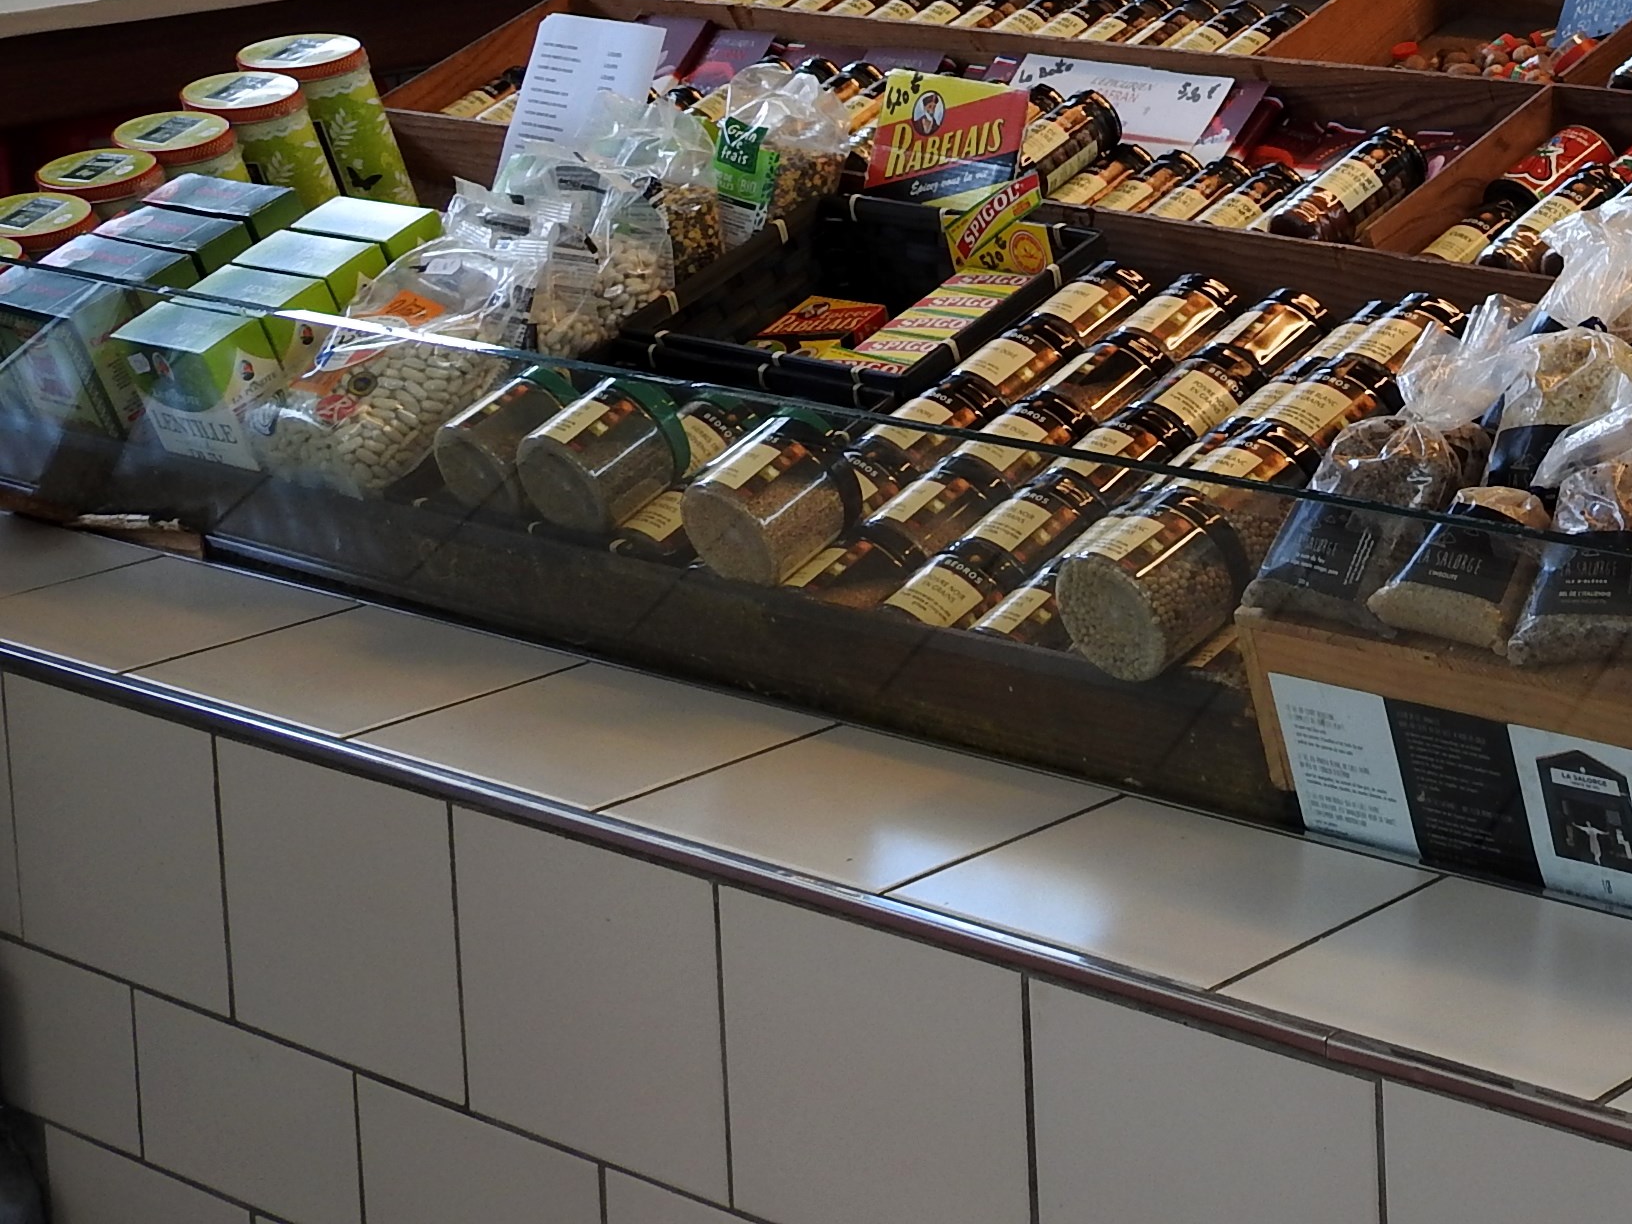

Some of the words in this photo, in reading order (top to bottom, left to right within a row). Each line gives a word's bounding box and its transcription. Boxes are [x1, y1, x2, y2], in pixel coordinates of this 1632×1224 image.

[885, 118, 1005, 178] RABELAIS
[963, 184, 1020, 252] SPIGOL
[1208, 366, 1244, 399] BEDROS
[151, 409, 238, 445] LENTILLE
[944, 557, 985, 586] BEDROS
